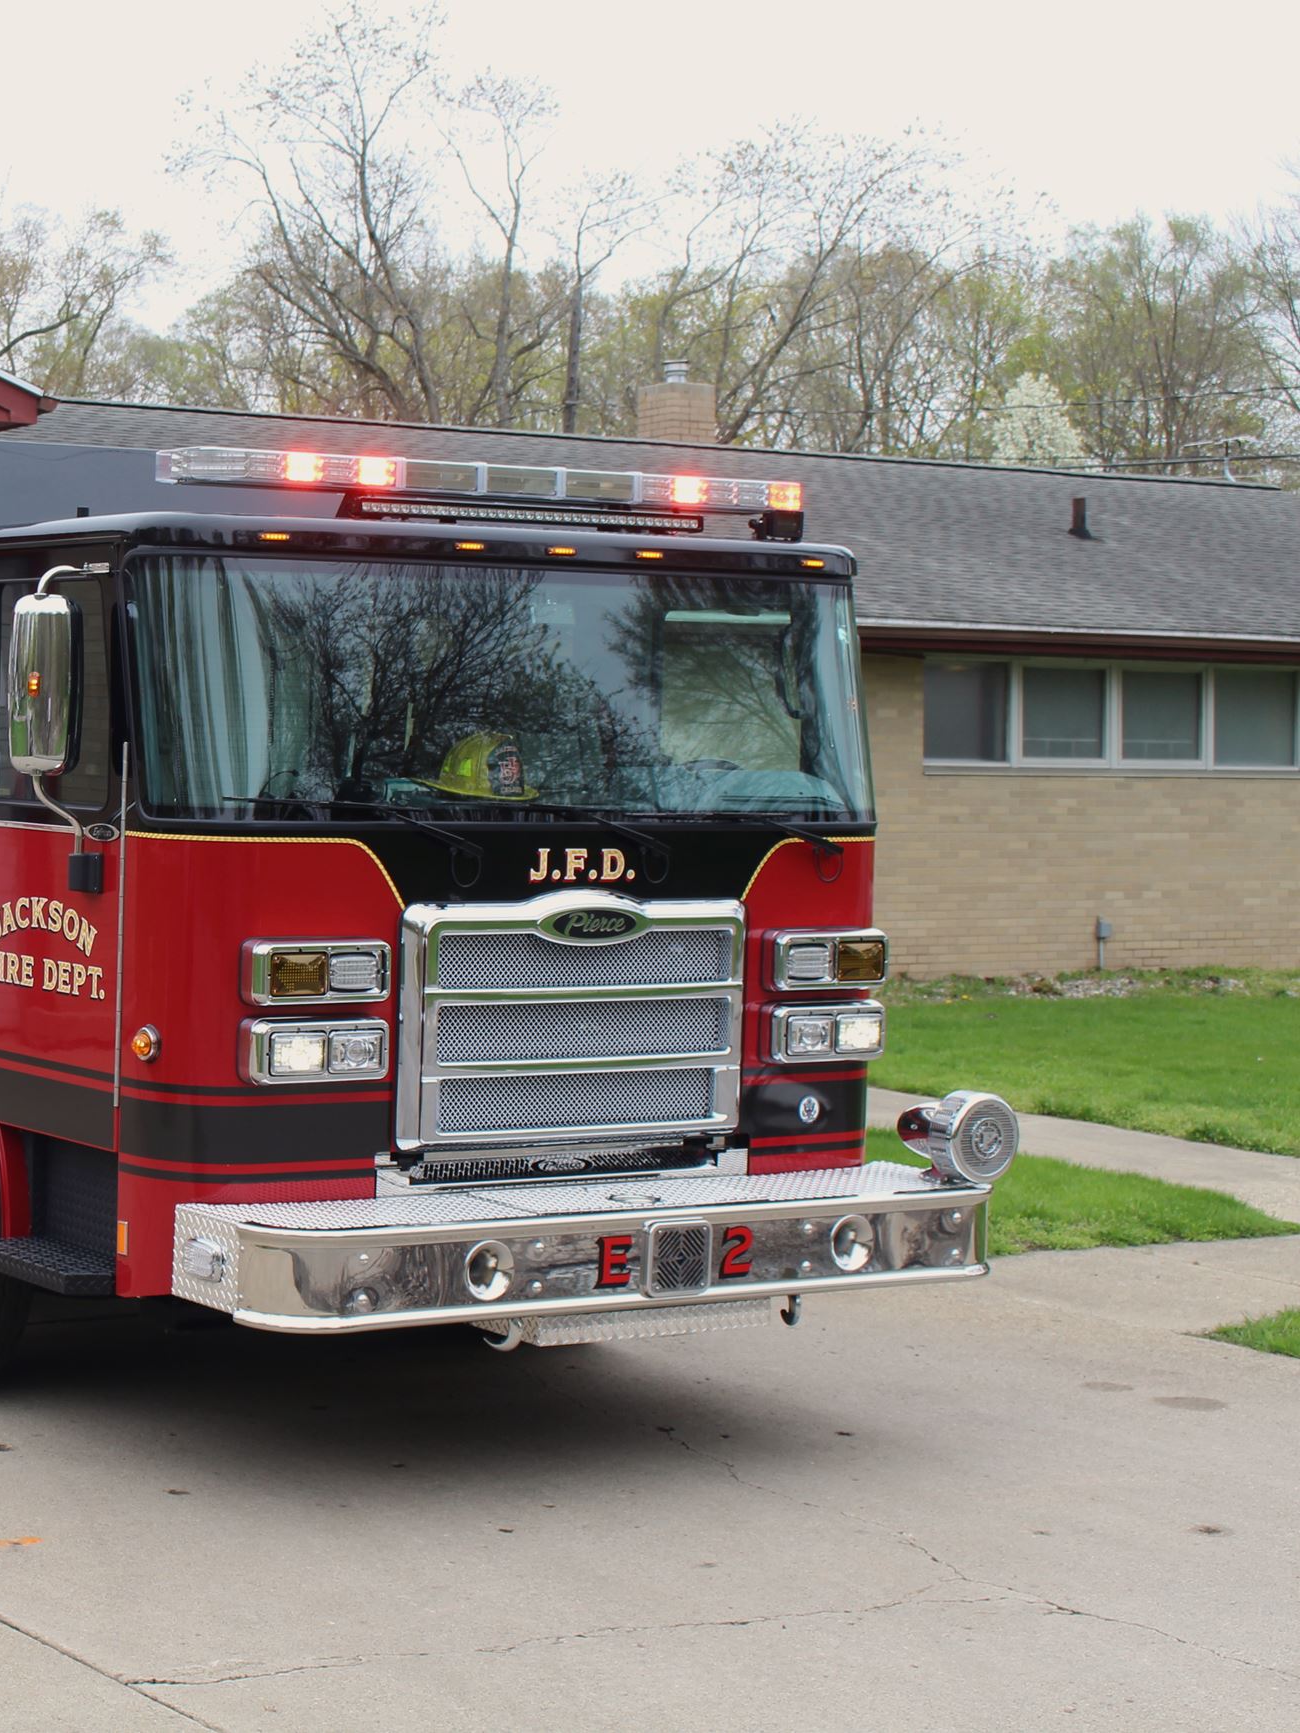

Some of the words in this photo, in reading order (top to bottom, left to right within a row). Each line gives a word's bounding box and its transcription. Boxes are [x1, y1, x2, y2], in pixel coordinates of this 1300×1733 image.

[529, 848, 636, 883] J.F.D.
[564, 911, 626, 937] Pierce
[42, 957, 105, 1000] DEPT.
[593, 1235, 632, 1289] E
[719, 1226, 754, 1279] 2
